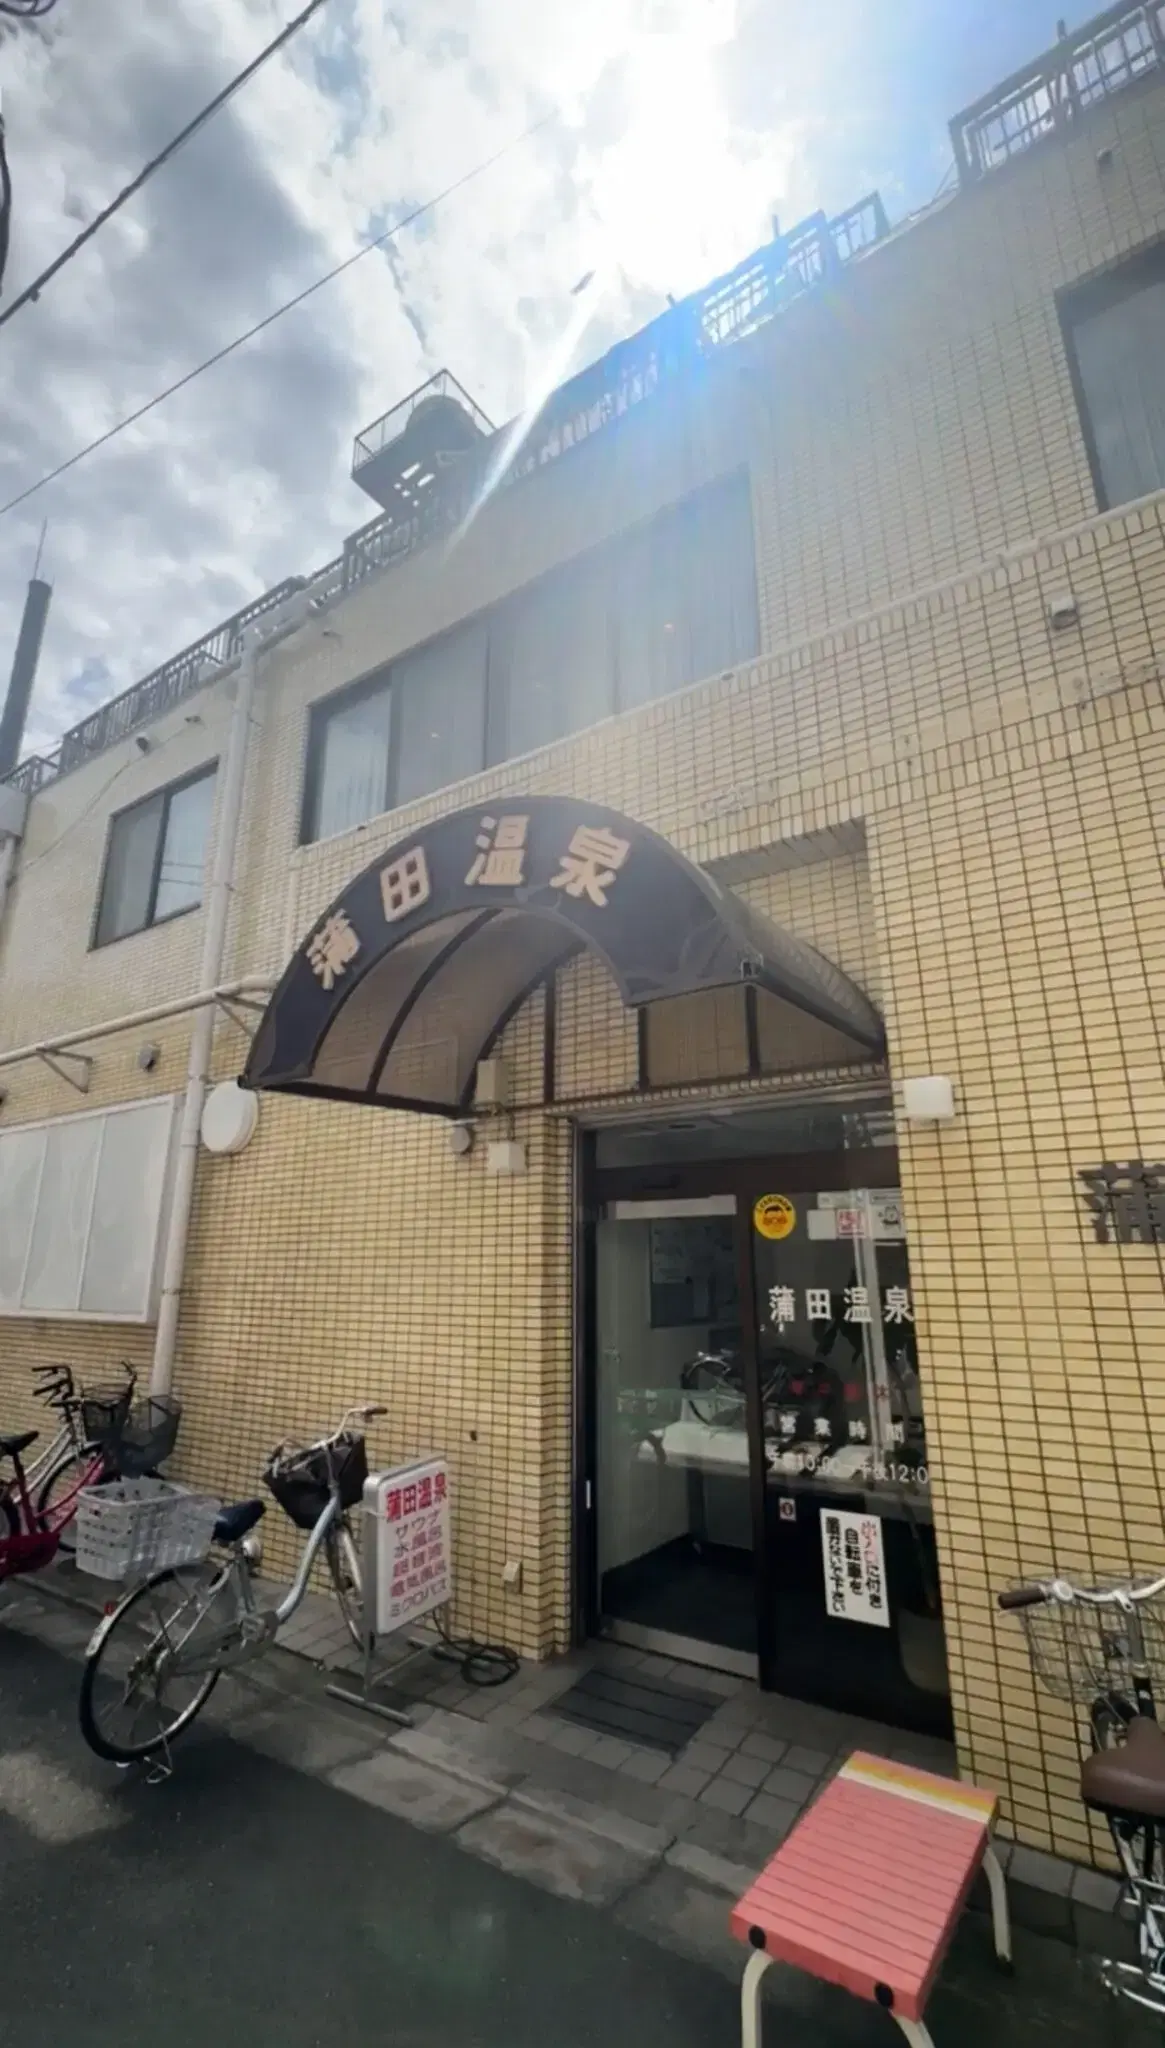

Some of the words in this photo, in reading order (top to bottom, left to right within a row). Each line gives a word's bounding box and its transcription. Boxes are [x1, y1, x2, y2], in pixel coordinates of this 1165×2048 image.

[306, 814, 631, 990] 蒲田温泉
[768, 1285, 914, 1324] 蒲田温泉
[386, 1472, 447, 1523] 蒲田温泉
